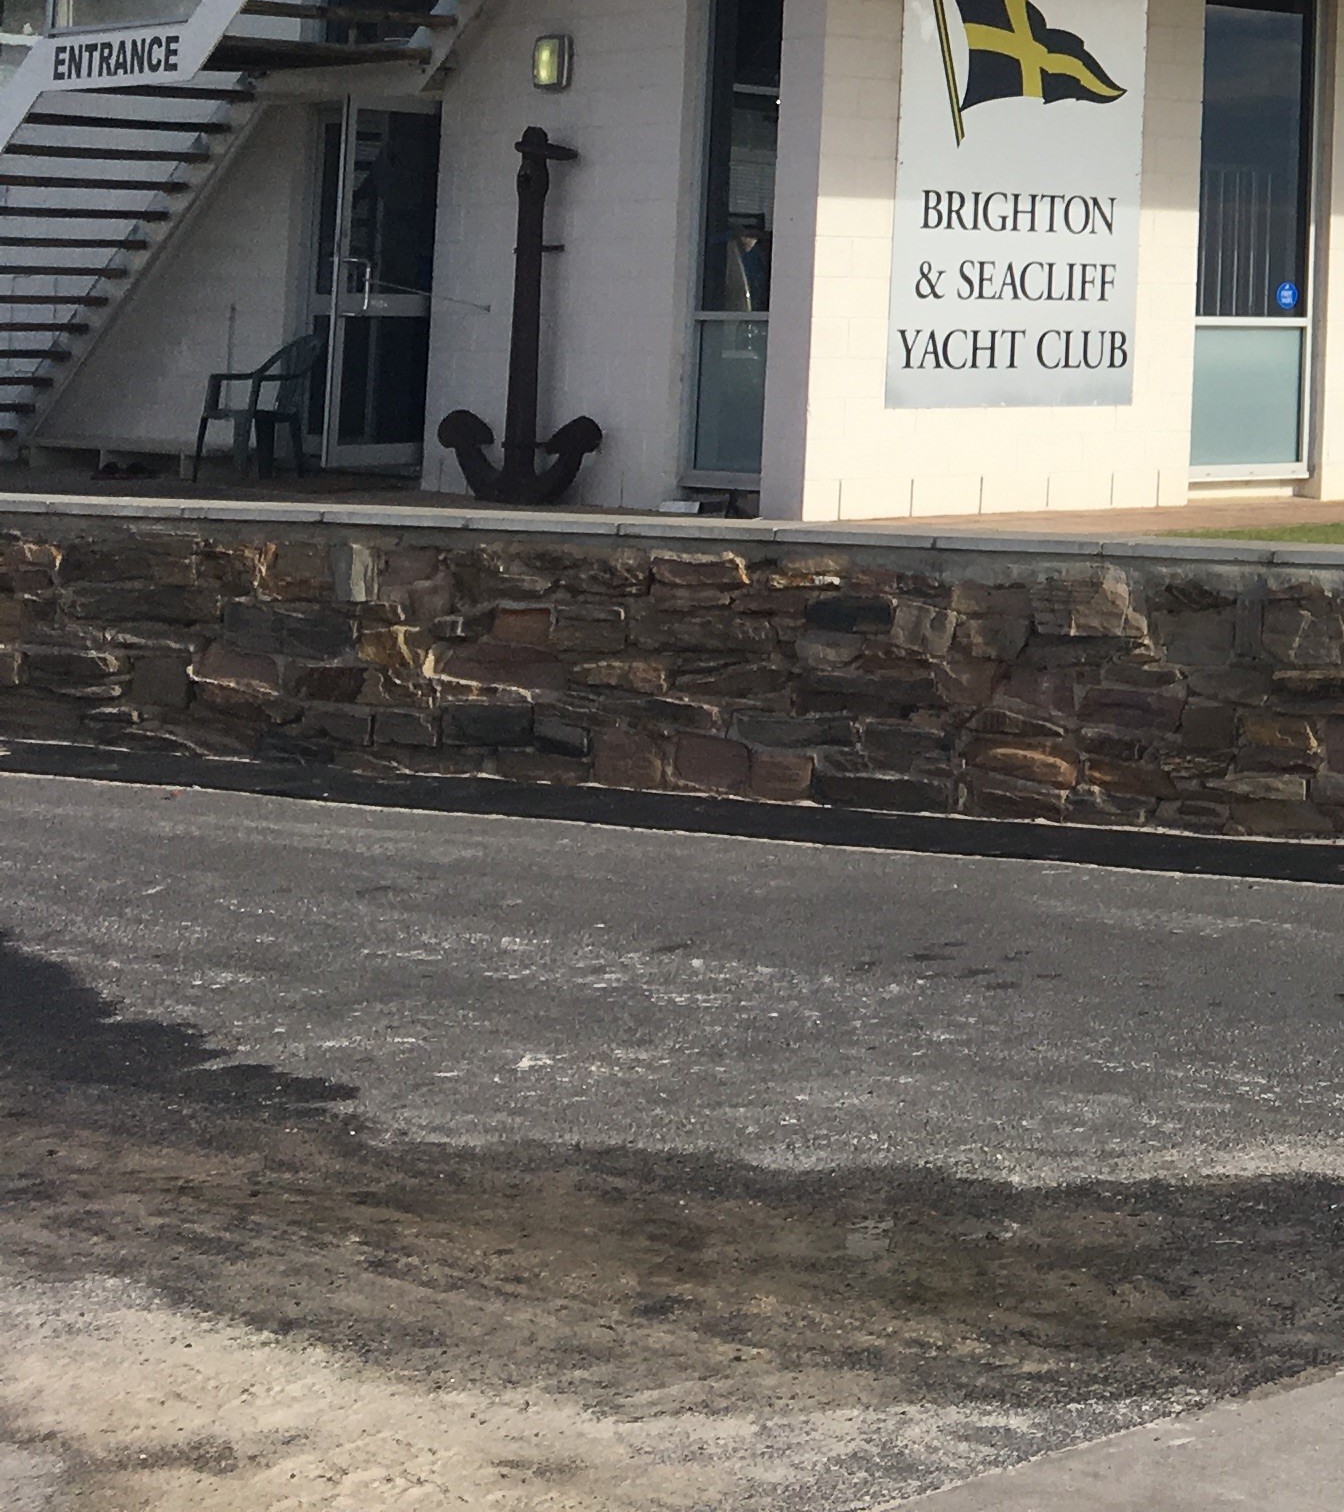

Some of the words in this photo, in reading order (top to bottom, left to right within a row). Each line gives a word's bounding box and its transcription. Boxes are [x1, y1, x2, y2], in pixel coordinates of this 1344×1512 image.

[53, 34, 180, 81] ENTRANCE
[920, 189, 1117, 236] BRIGHTON
[914, 260, 946, 300] &
[957, 259, 1117, 302] SEACLIFF
[897, 328, 1026, 370] YACHT
[1036, 328, 1129, 370] CLUB
